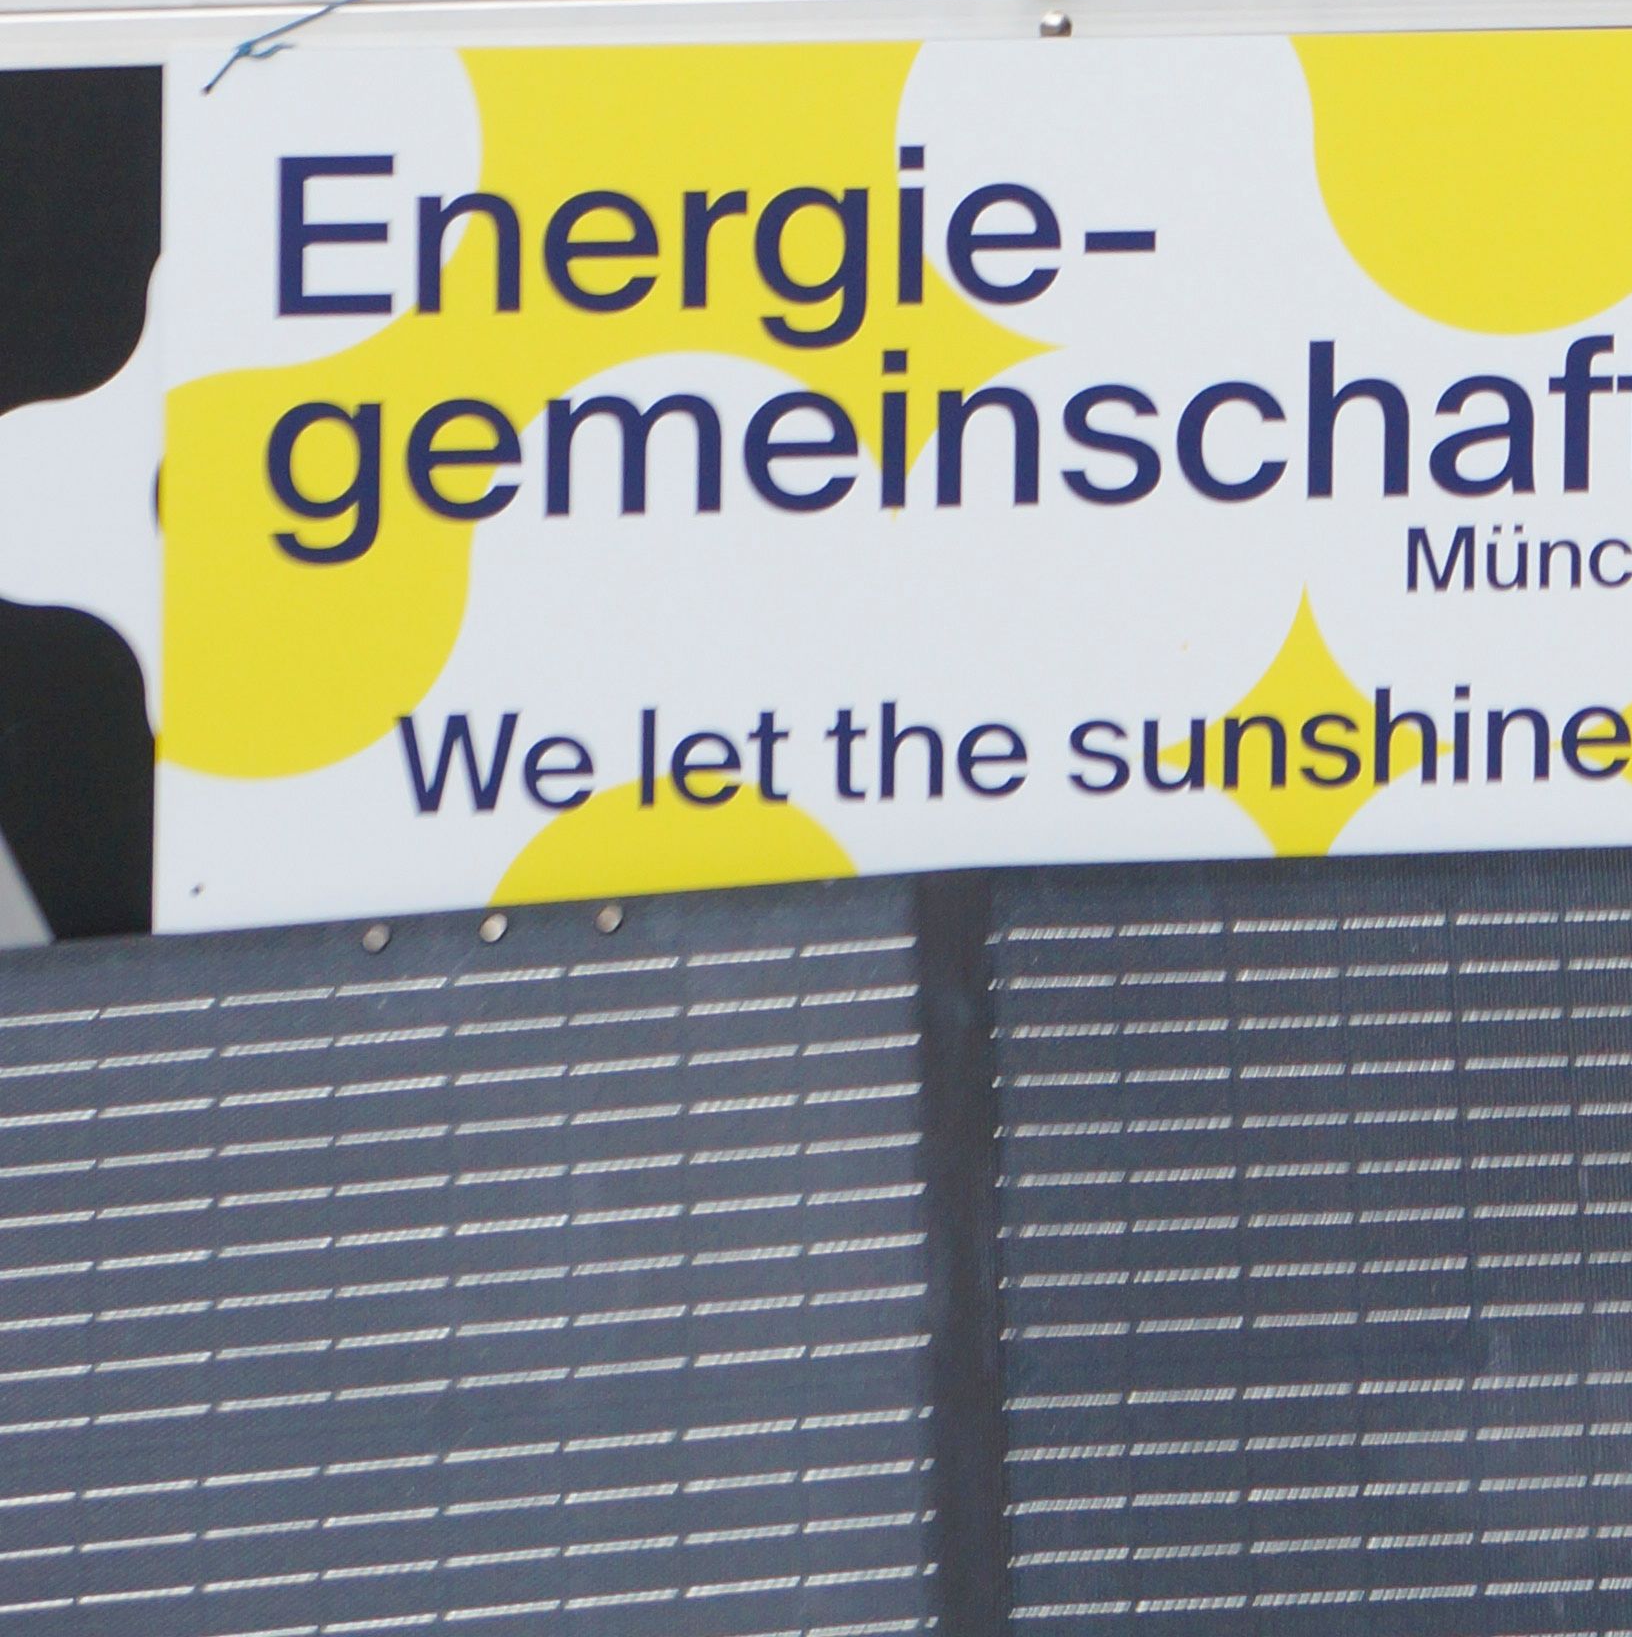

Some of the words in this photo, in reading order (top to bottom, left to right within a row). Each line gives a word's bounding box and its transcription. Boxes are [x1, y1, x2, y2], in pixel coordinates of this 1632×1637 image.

[278, 145, 1156, 349] Energie-
[397, 711, 595, 815] We
[640, 708, 790, 807] let
[824, 700, 1029, 801] the
[1068, 685, 1632, 795] sunshine
